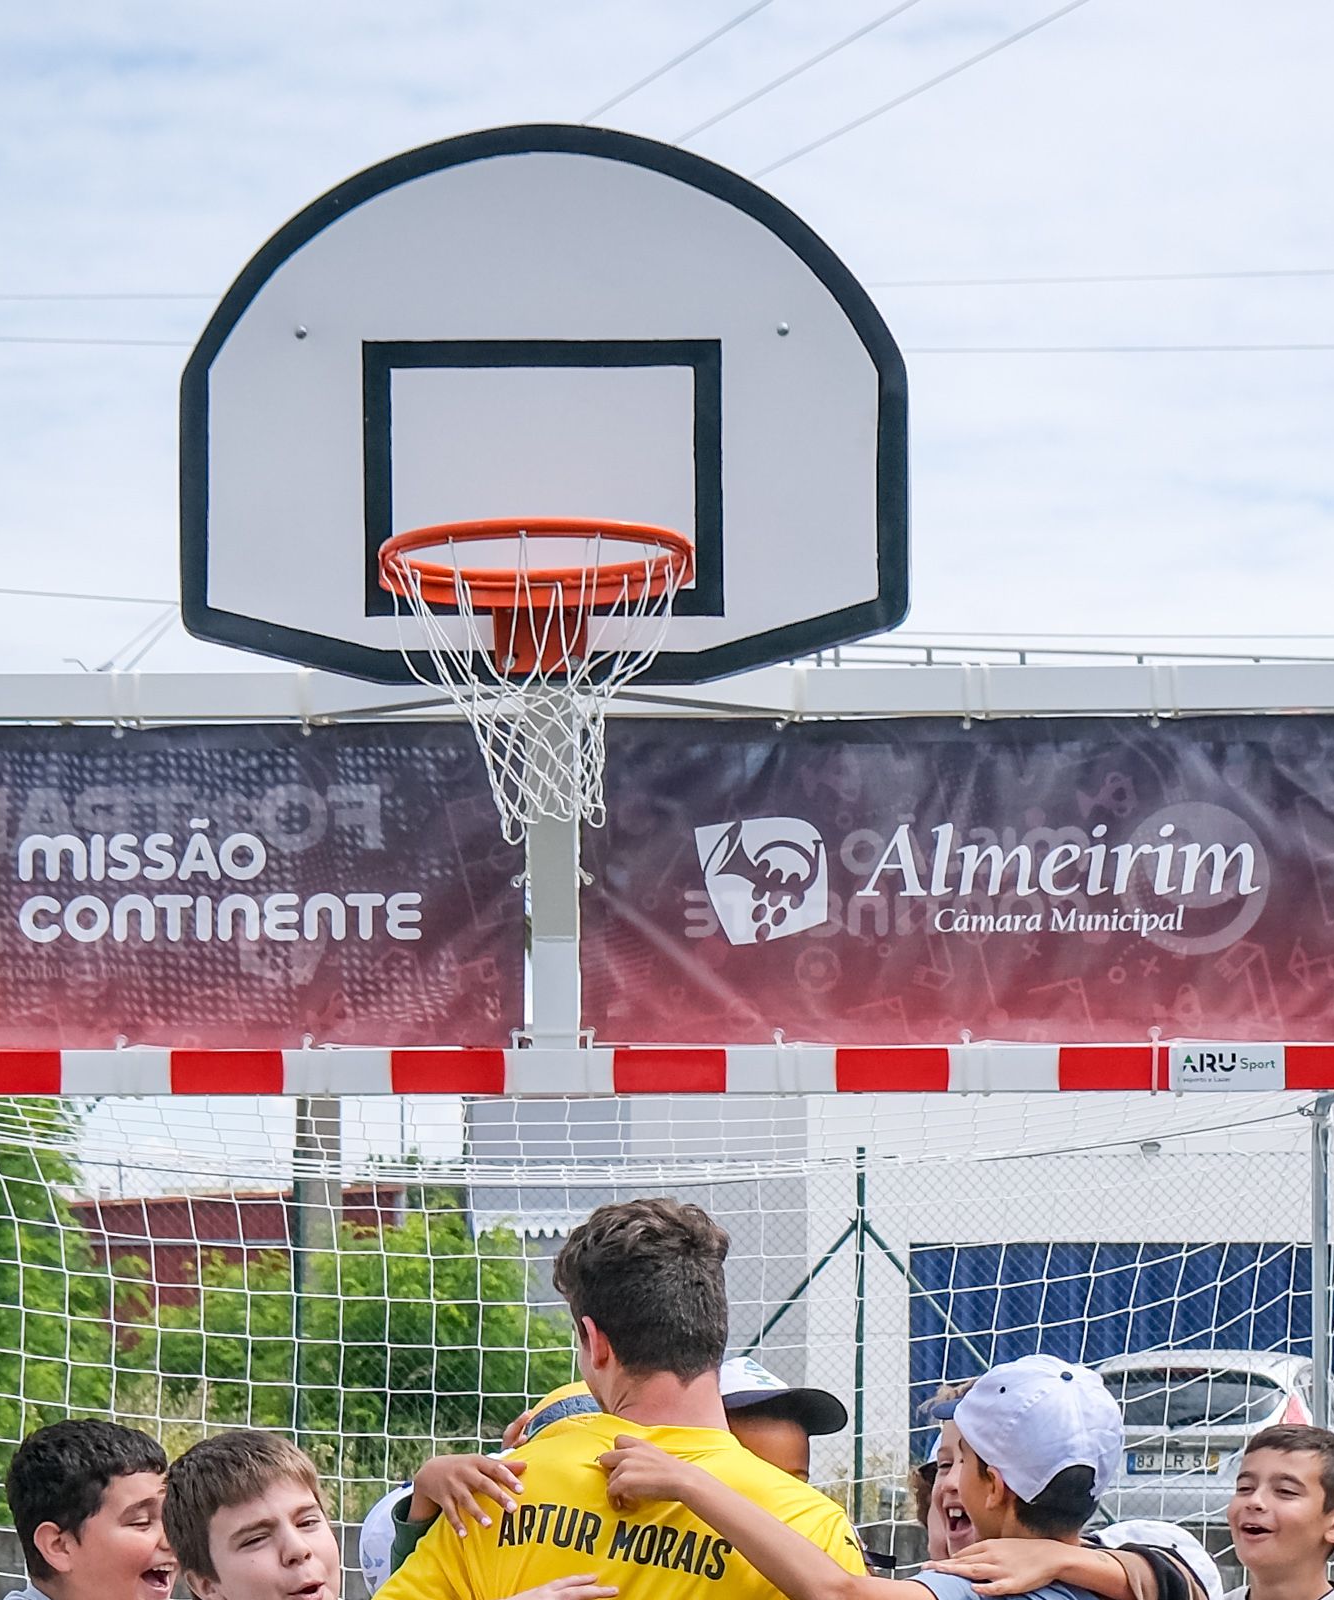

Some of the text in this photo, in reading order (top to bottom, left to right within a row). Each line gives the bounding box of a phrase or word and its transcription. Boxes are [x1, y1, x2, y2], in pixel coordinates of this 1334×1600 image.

[18, 817, 267, 882] MISSÃO
[856, 822, 1262, 898] Almeirim
[18, 892, 422, 943] CONTINENTE
[934, 904, 1184, 937] Câmara Municipal
[1183, 1053, 1276, 1072] ARU Sport
[1136, 1454, 1155, 1468] 83
[498, 1503, 734, 1581] ARTUR MORAIS
